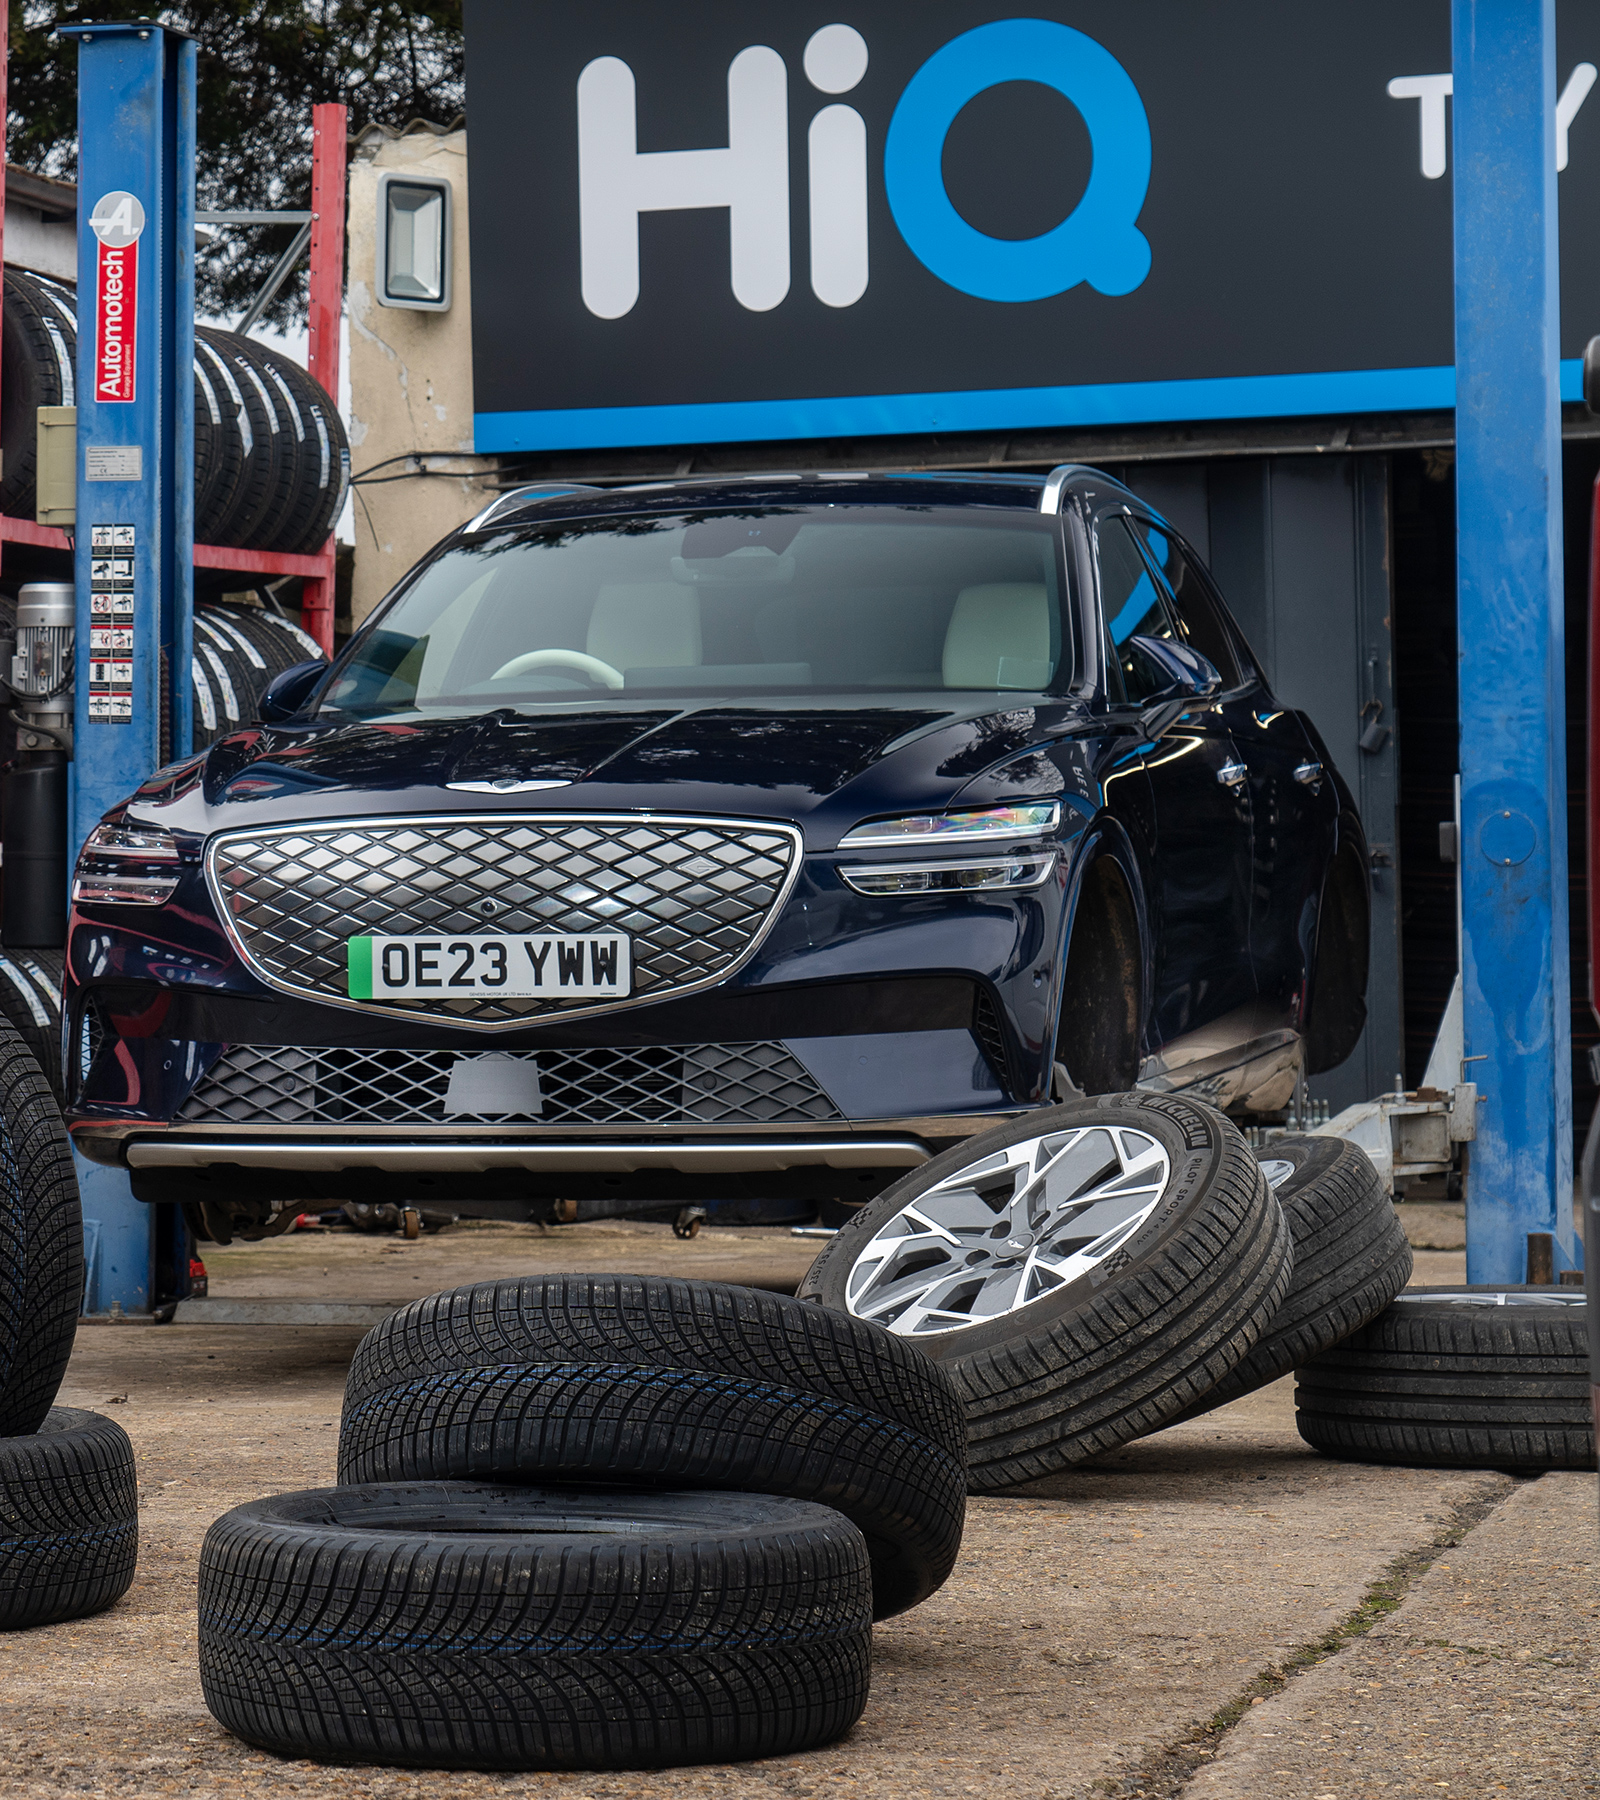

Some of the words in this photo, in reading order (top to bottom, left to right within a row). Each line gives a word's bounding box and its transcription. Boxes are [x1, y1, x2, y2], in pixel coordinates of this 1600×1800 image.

[577, 18, 1152, 320] HiQ
[99, 250, 124, 397] Automotech
[123, 372, 131, 398] Garage
[382, 942, 508, 988] OE23
[524, 940, 618, 987] YWW
[1143, 1096, 1209, 1149] MICHELIN
[1184, 1157, 1203, 1186] PILOT
[1159, 1187, 1189, 1224] SPORT
[1136, 1229, 1154, 1246] SUV
[808, 1254, 830, 1286] 235/55
